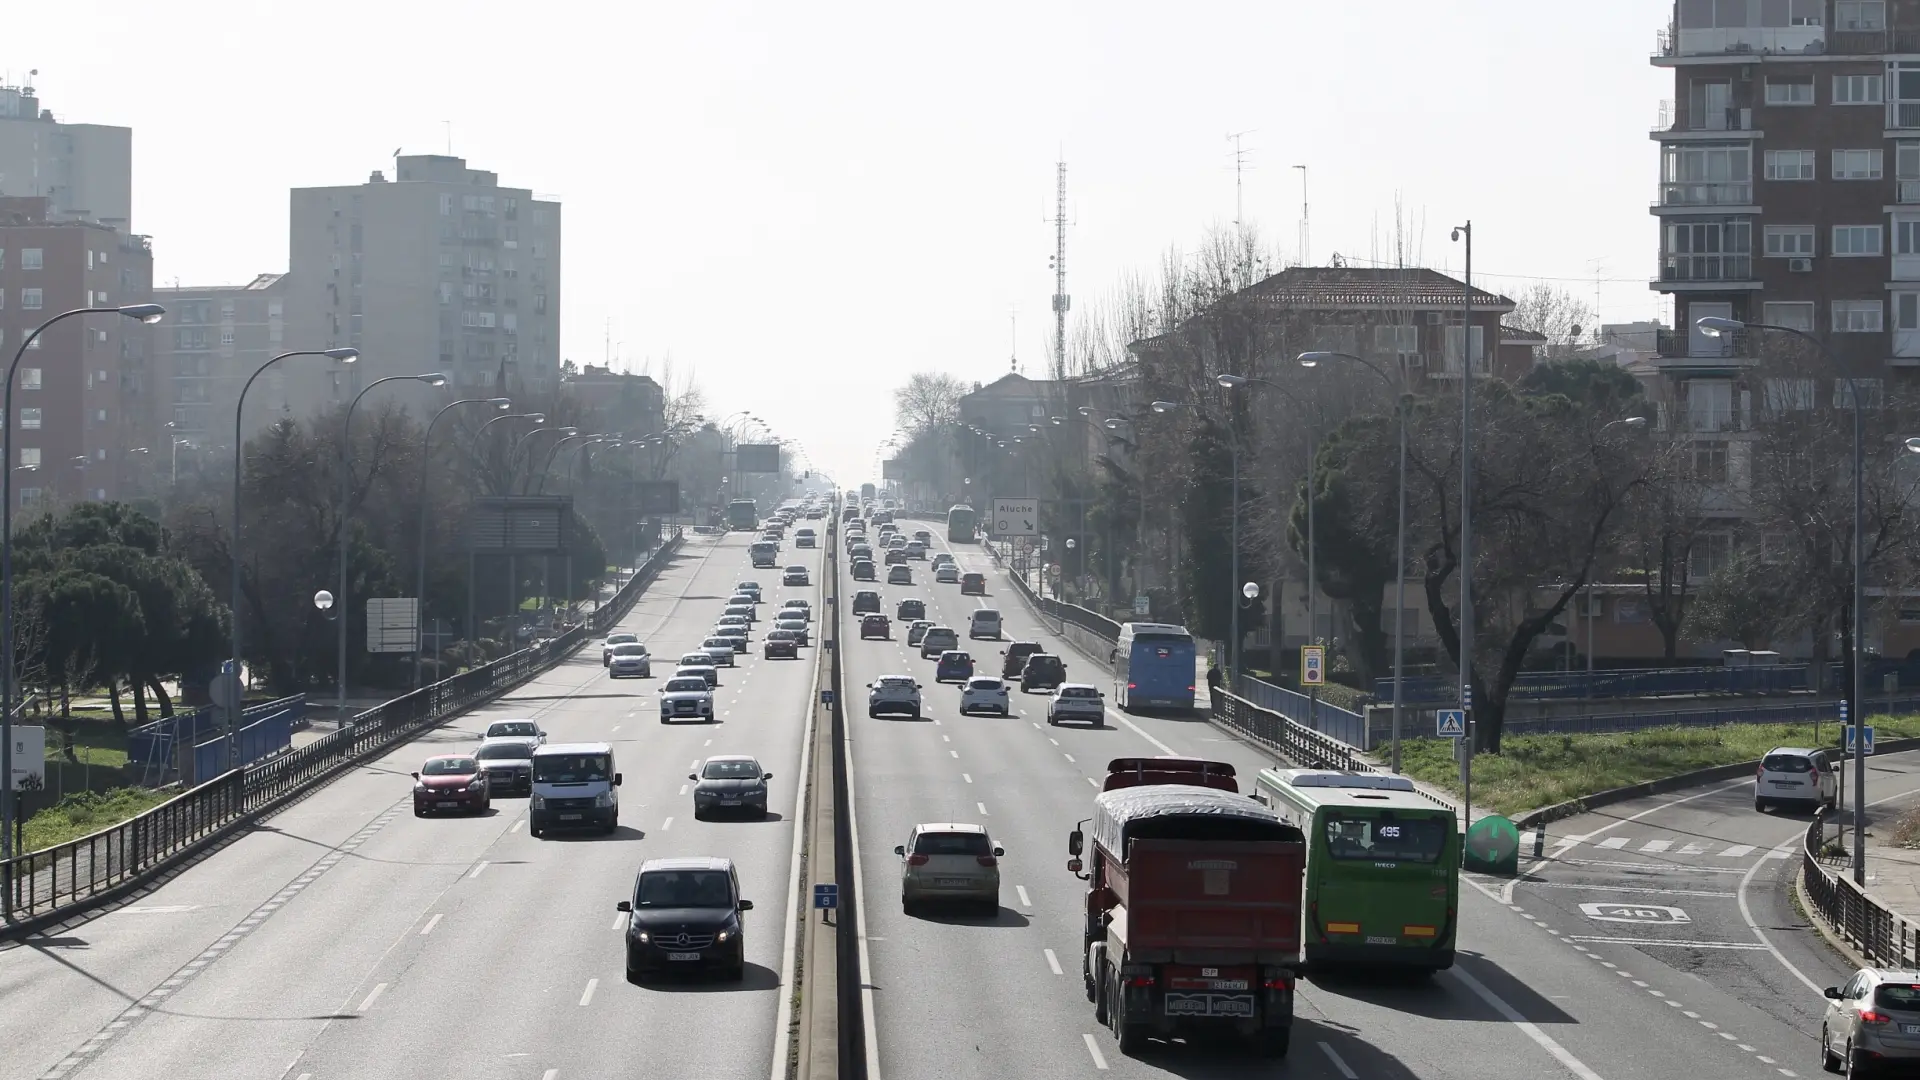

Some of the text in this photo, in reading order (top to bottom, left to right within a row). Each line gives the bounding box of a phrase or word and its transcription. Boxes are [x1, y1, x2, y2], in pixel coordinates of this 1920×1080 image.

[1000, 505, 1033, 513] Aluche
[1379, 826, 1400, 837] 495
[1610, 909, 1660, 918] 40
[1203, 968, 1217, 976] SP
